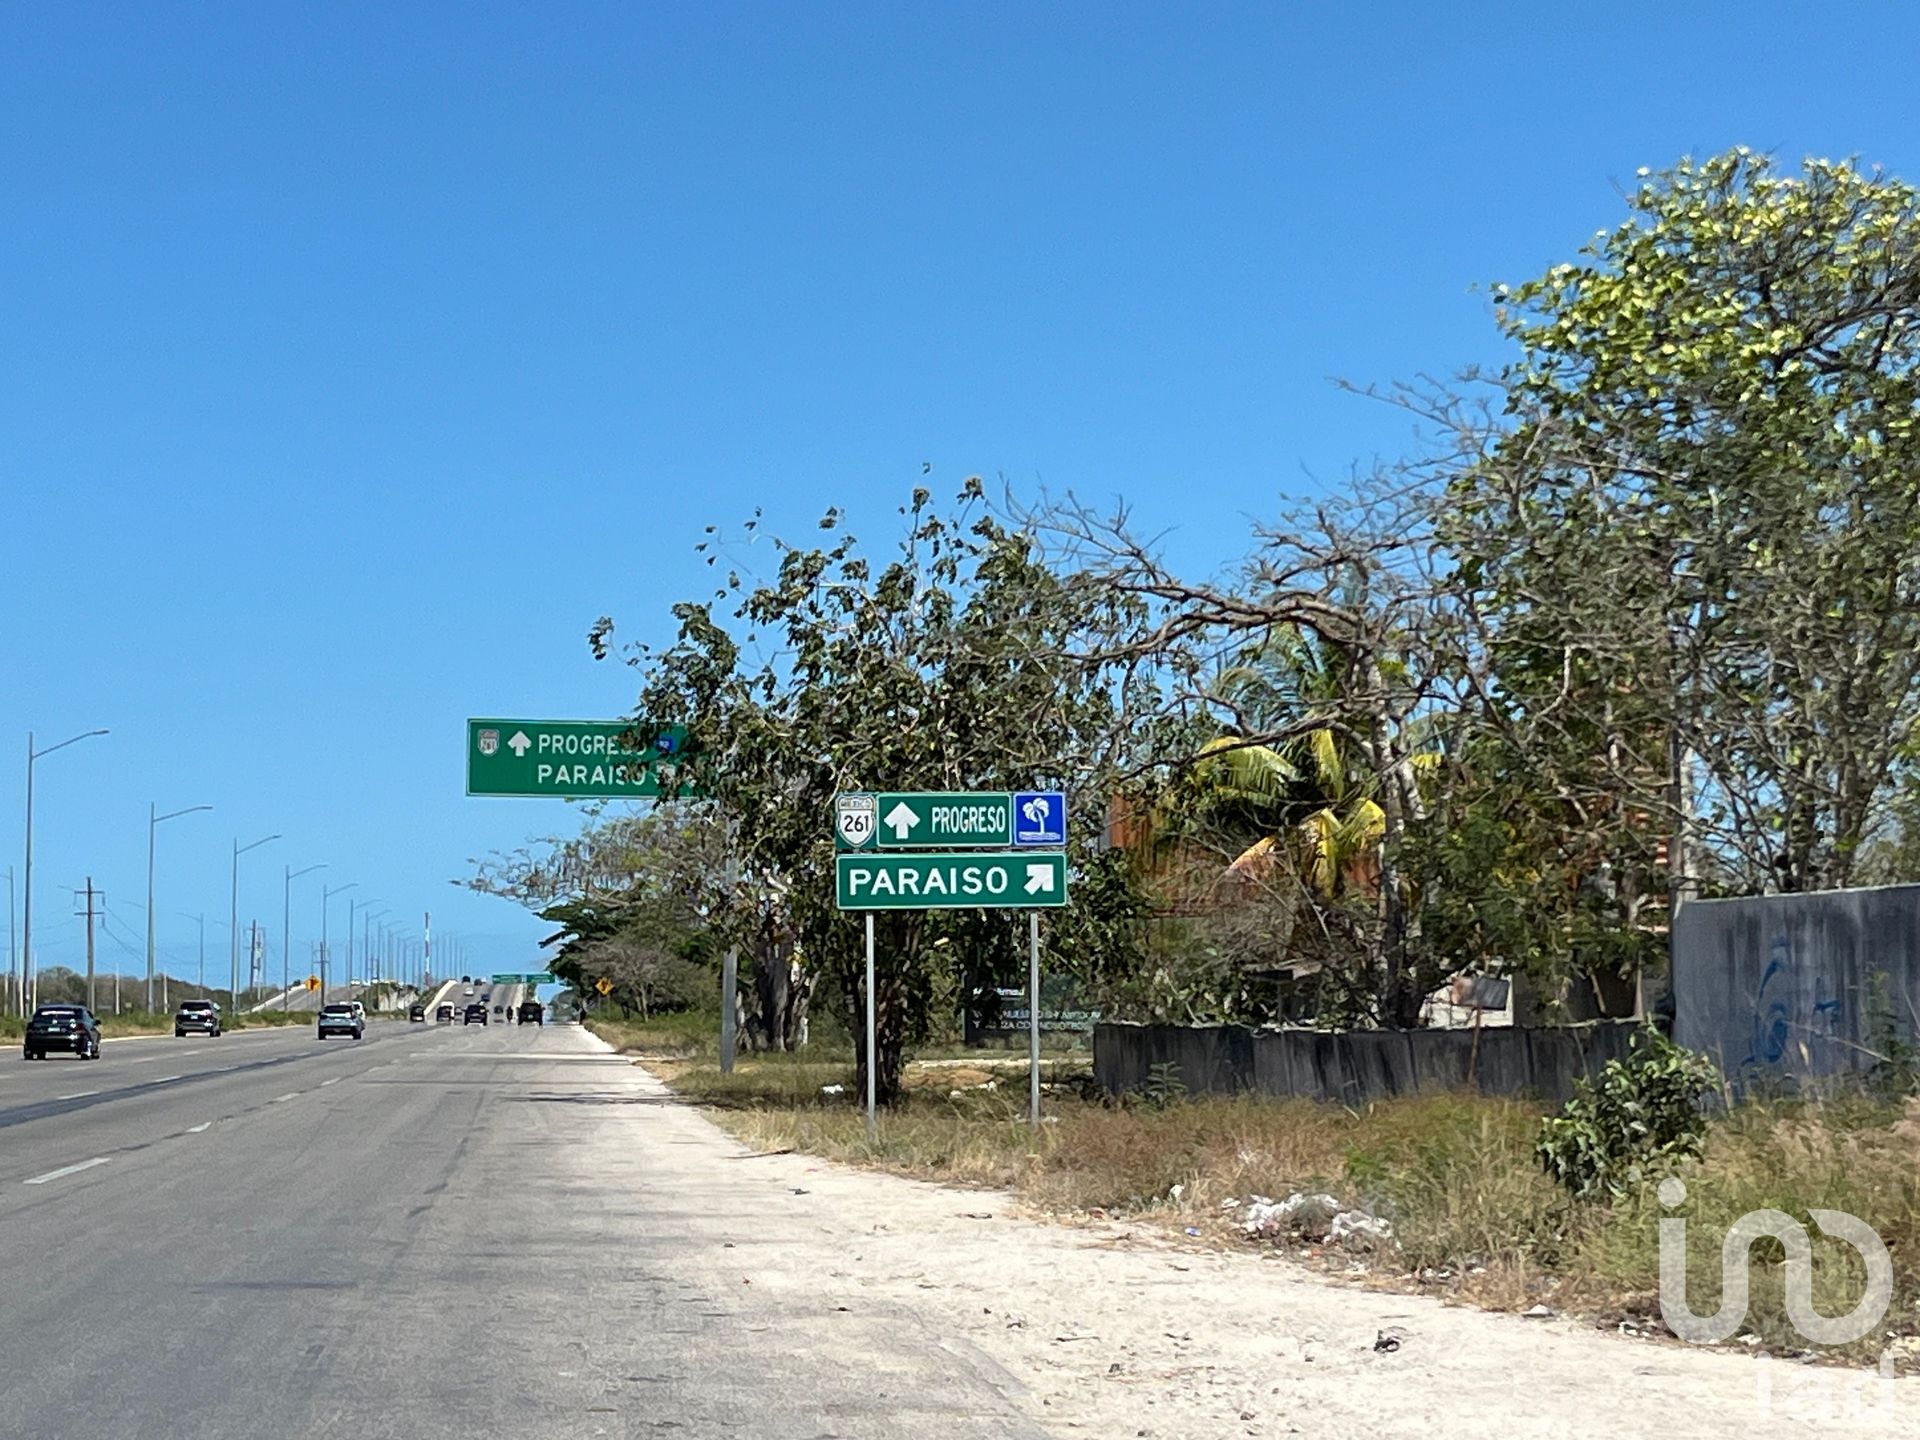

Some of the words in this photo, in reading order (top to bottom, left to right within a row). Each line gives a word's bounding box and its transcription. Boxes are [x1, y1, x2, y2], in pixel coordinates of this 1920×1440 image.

[844, 814, 869, 832] 261
[931, 806, 1006, 834] PROGRESO
[849, 866, 1008, 896] PARAISO
